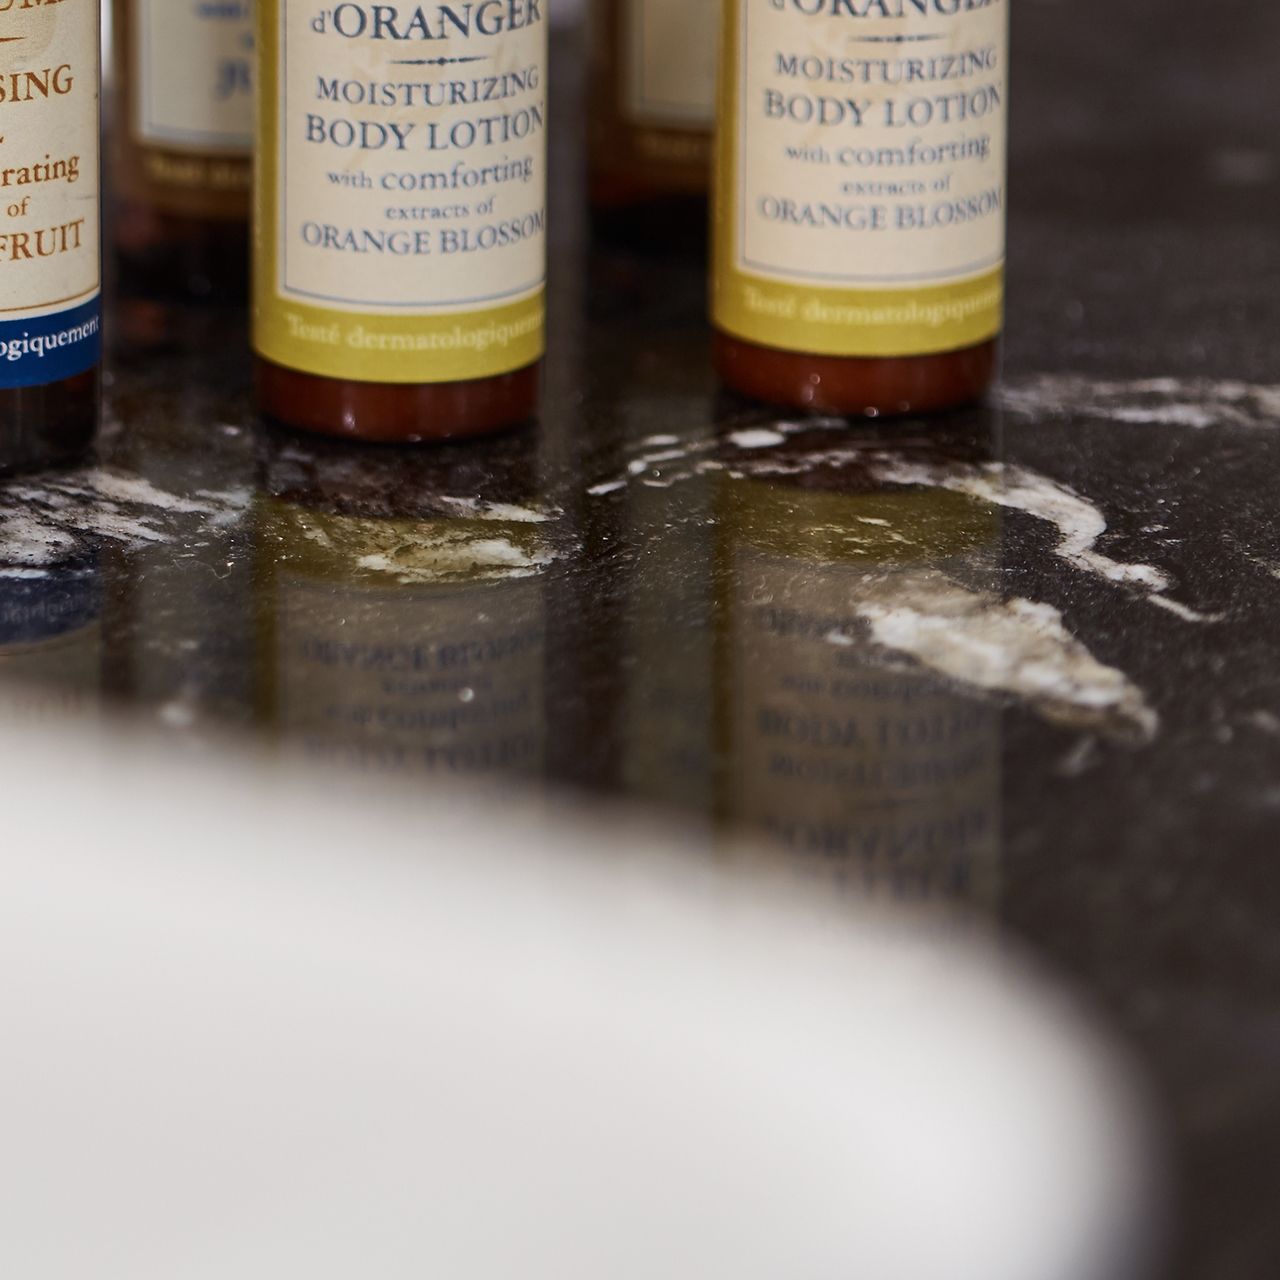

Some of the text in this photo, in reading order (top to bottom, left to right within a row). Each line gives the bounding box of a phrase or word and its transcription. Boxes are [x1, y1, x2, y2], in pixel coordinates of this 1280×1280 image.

[775, 45, 997, 84] MOISTURIZING
[316, 65, 538, 106] MOISTURIZING
[763, 88, 872, 128] BODY
[305, 113, 416, 150] BODY
[784, 132, 992, 168] with comforting
[327, 154, 533, 191] with comforting
[934, 173, 954, 192] of
[7, 196, 31, 219] of
[385, 195, 496, 220] extracts of
[758, 195, 888, 231] ORANGE
[301, 222, 431, 255] ORANGE
